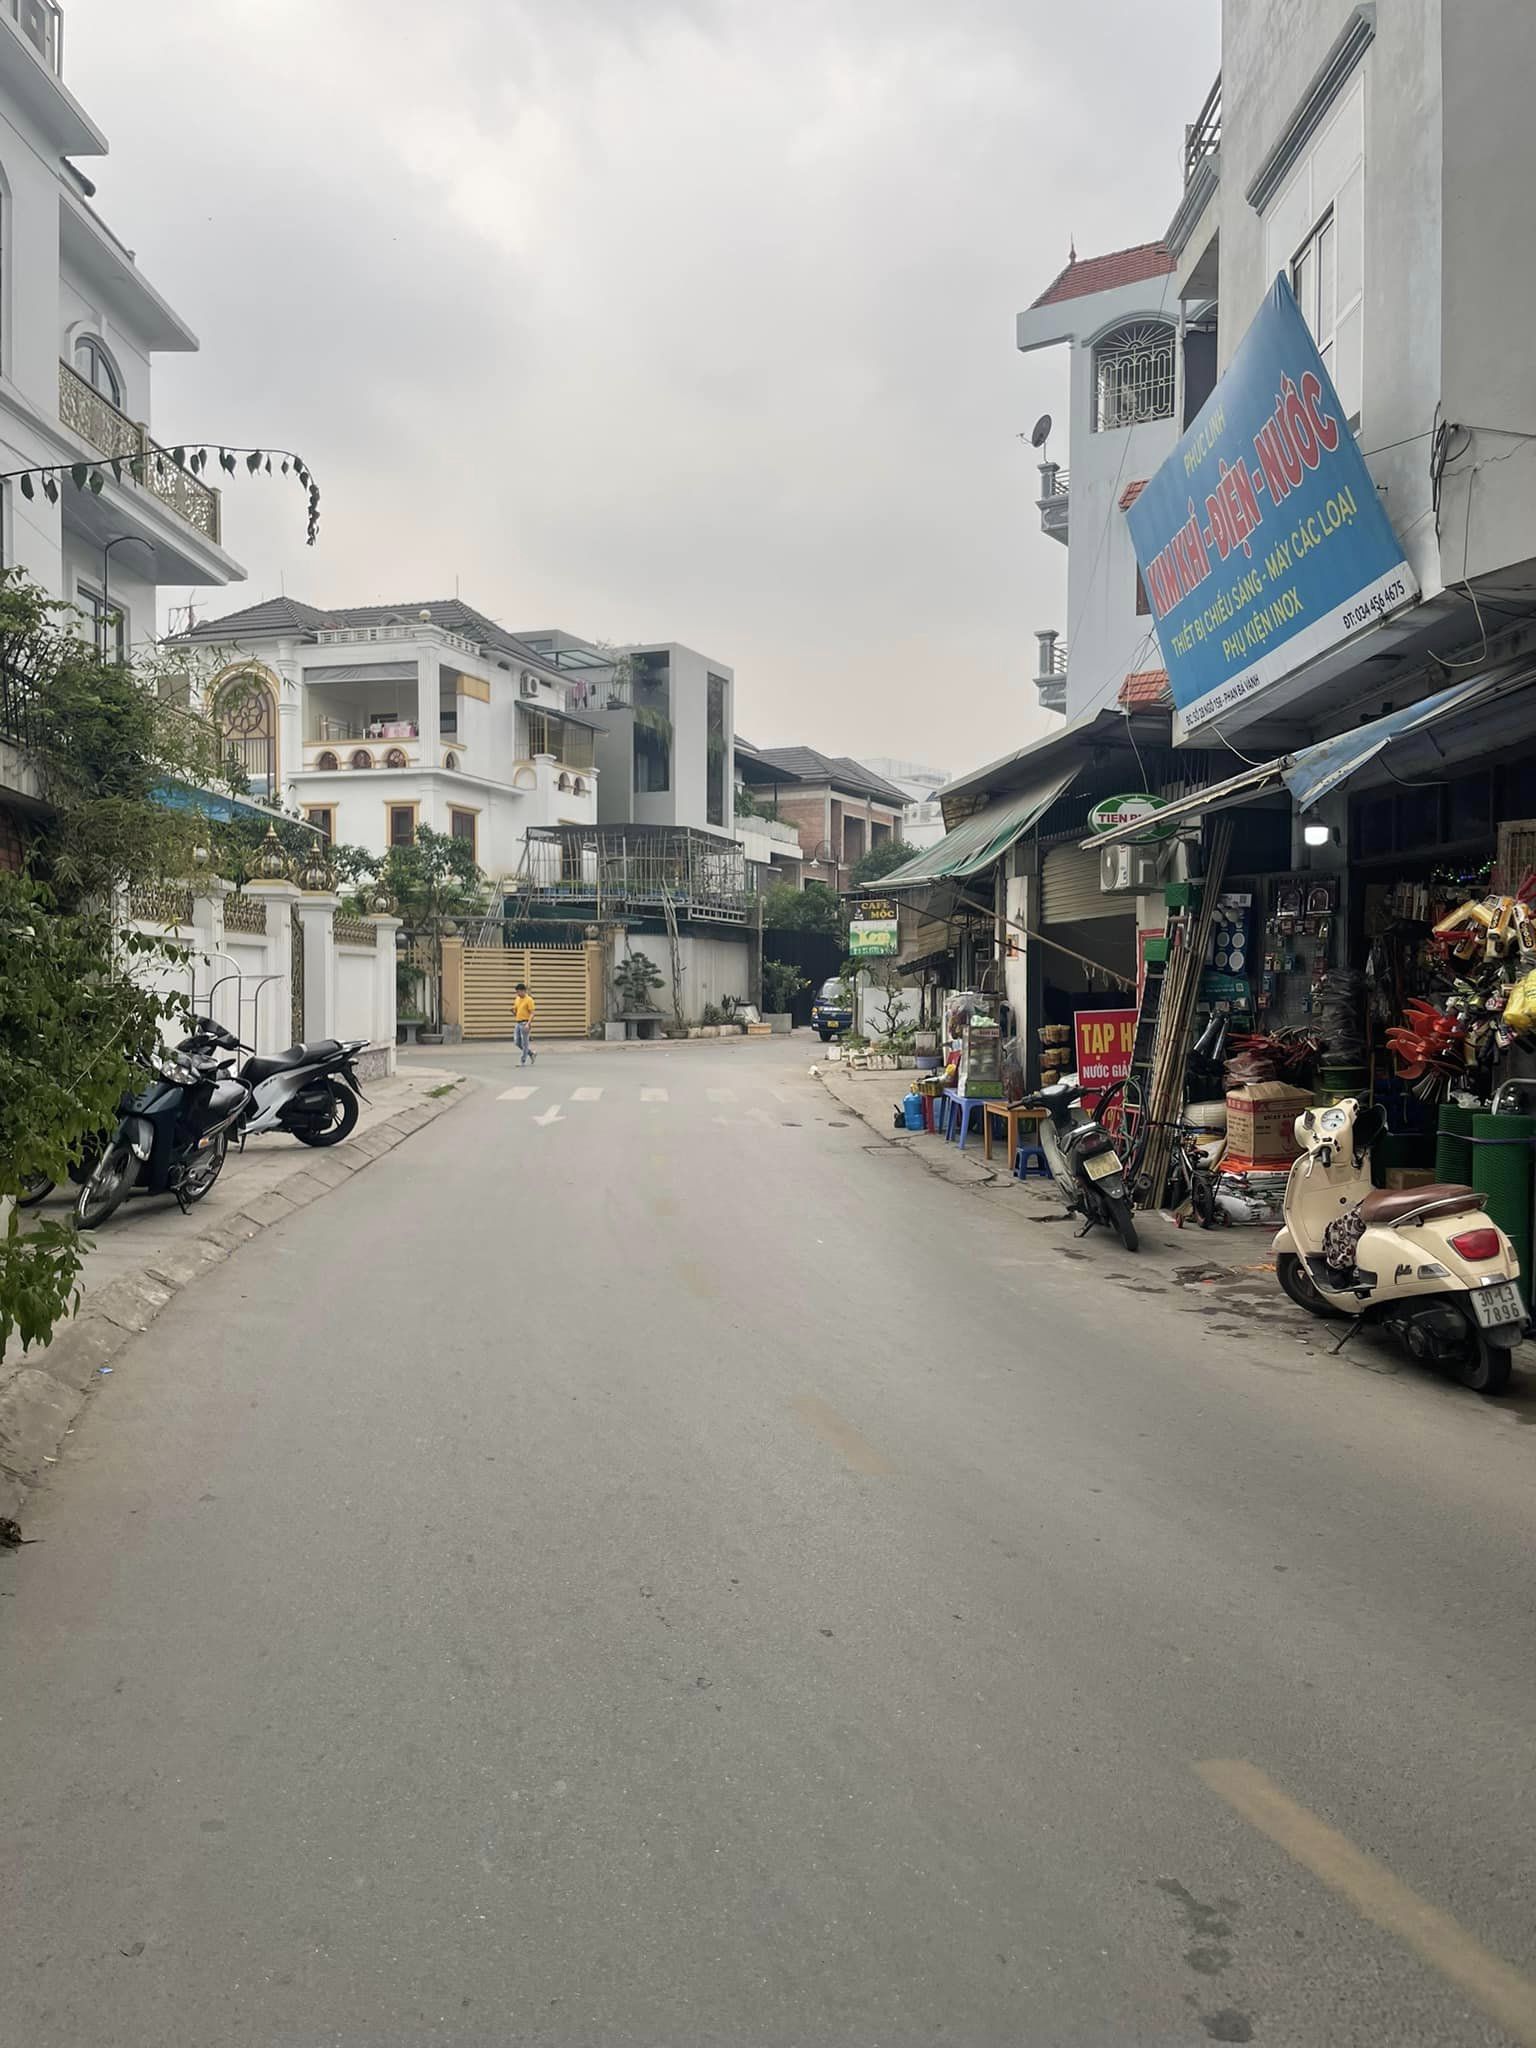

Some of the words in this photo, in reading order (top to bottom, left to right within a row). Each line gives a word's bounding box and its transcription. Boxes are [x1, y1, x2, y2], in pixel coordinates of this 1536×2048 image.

[1204, 402, 1226, 448] LINH
[1146, 543, 1184, 621] KIM
[1194, 616, 1208, 642] BỊ
[1231, 568, 1263, 610] SÁNG
[1264, 540, 1293, 582] MÁY
[1291, 519, 1321, 559] CÁC
[1317, 485, 1357, 537] LOẠI
[1384, 579, 1405, 602] 4675
[1222, 628, 1248, 663] PHỤ
[1243, 608, 1273, 648] KIỆN
[1270, 586, 1304, 627] INOX
[1081, 1023, 1115, 1061] TẠP
[1082, 1061, 1110, 1079] NƯỚC
[1483, 1303, 1520, 1325] 7896
